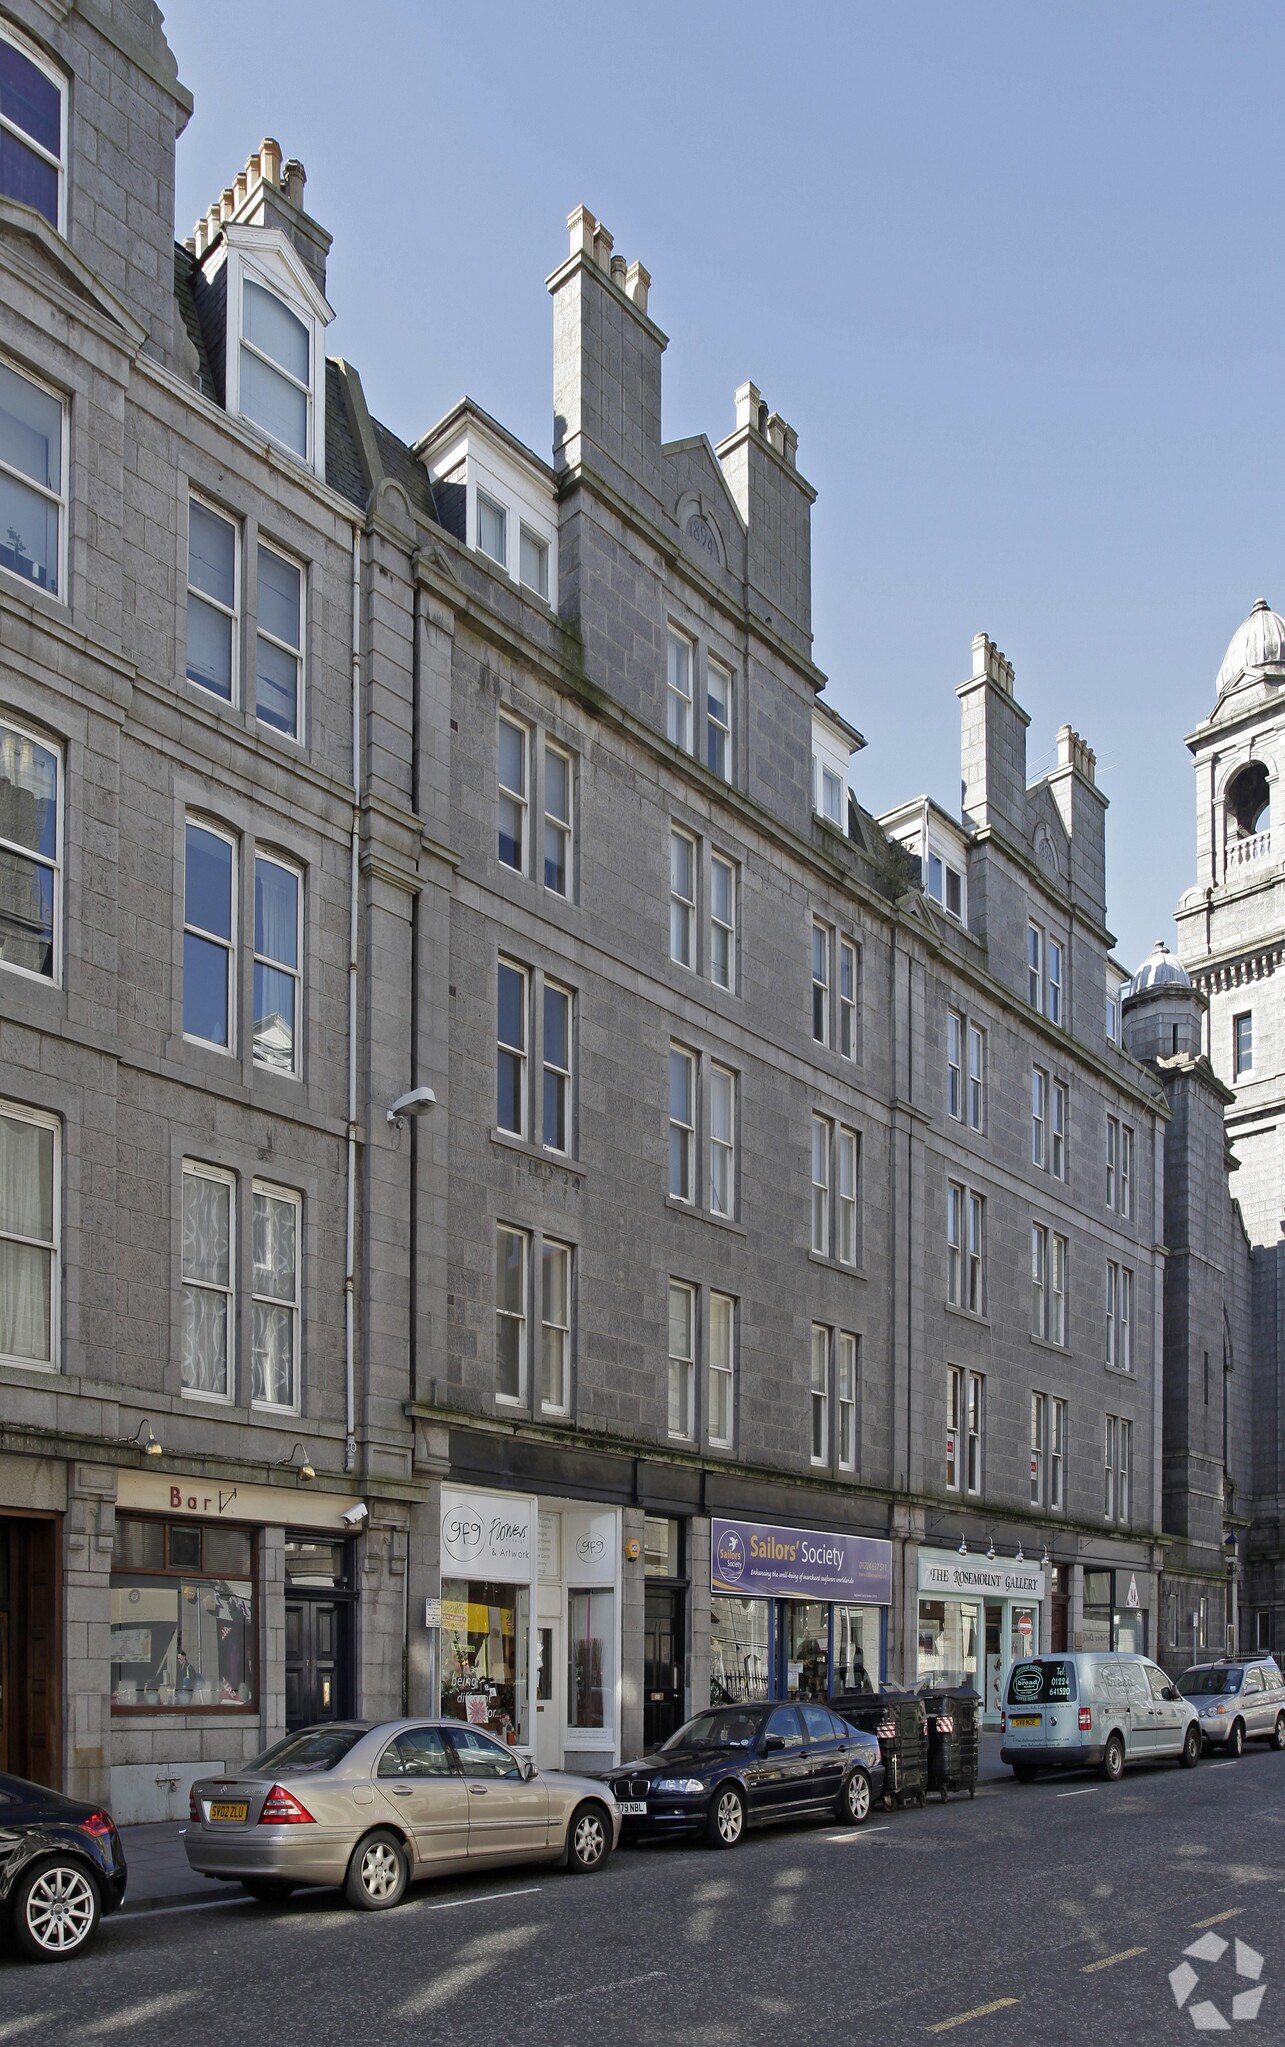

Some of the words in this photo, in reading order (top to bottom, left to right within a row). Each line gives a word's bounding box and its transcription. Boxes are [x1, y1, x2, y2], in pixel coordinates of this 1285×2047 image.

[170, 1486, 212, 1510] Bar
[491, 1547, 496, 1556] &
[500, 1549, 530, 1559] Artwork
[750, 1535, 799, 1561] Sailors'
[801, 1541, 844, 1571] Society
[727, 1560, 742, 1569] Society
[750, 1568, 771, 1580] Enhancing
[803, 1573, 820, 1581] merchant
[930, 1568, 948, 1582] THE
[953, 1570, 1001, 1587] ROSEMOUNT
[1005, 1576, 1038, 1591] GALLERY
[451, 1671, 478, 1689] being
[1051, 1677, 1069, 1685] 01224
[1049, 1687, 1071, 1696] 641520
[212, 1806, 229, 1817] SV02
[230, 1806, 243, 1817] ZLU
[630, 1803, 643, 1812] NBL
